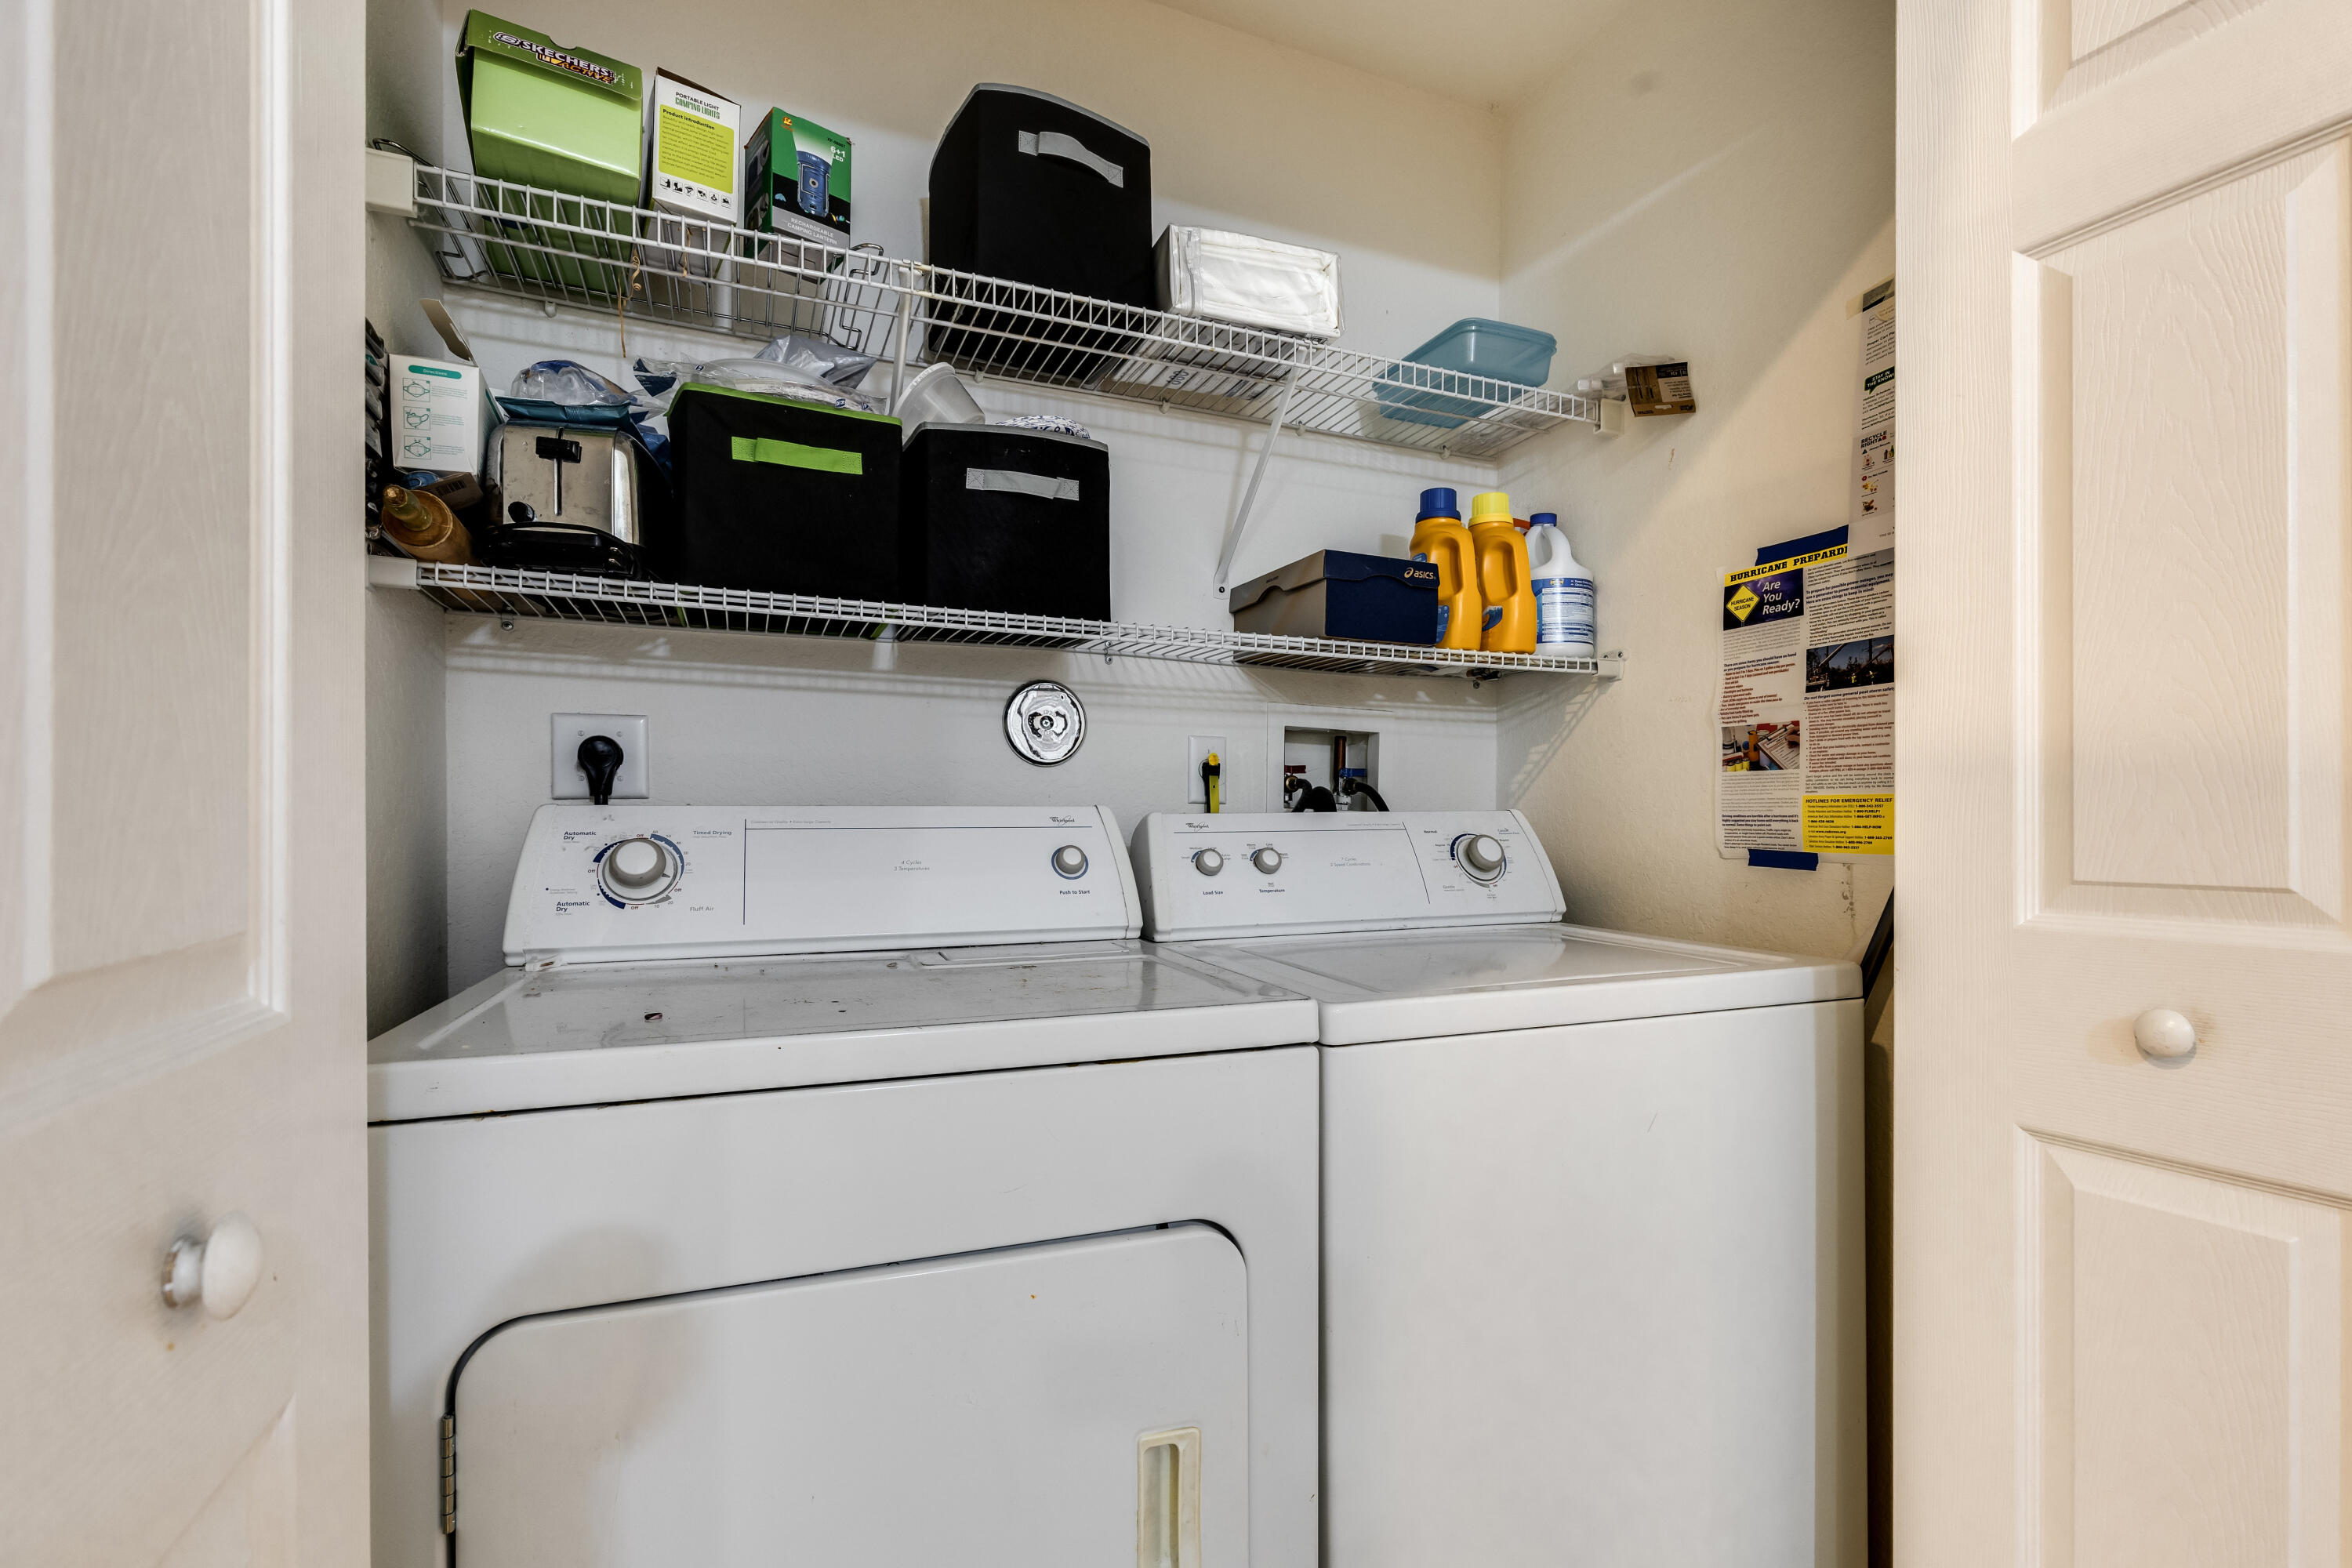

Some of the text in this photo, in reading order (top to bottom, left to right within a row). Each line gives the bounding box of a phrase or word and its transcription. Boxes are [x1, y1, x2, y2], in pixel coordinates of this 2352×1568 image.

[521, 40, 610, 76] SKECHERS
[560, 62, 613, 84] ACTIVE
[675, 92, 720, 111] PORTABLE LIGHT
[675, 97, 720, 120] CAMPING LIGHTS
[663, 109, 715, 130] Product introduction
[831, 146, 846, 158] 6+1
[832, 153, 843, 162] LED
[787, 222, 837, 245] CAMPING LANTERN
[791, 217, 834, 238] RECHARGEABLE
[1872, 373, 1883, 381] STAY
[1861, 430, 1887, 444] RECYCLE
[1861, 438, 1878, 448] RIGHT
[1414, 570, 1434, 579] asics
[1730, 561, 1787, 582] HURRICANE
[1762, 581, 1781, 592] Are
[1731, 596, 1754, 605] HURRICANE
[1764, 592, 1782, 603] You
[1763, 598, 1800, 615] Ready?
